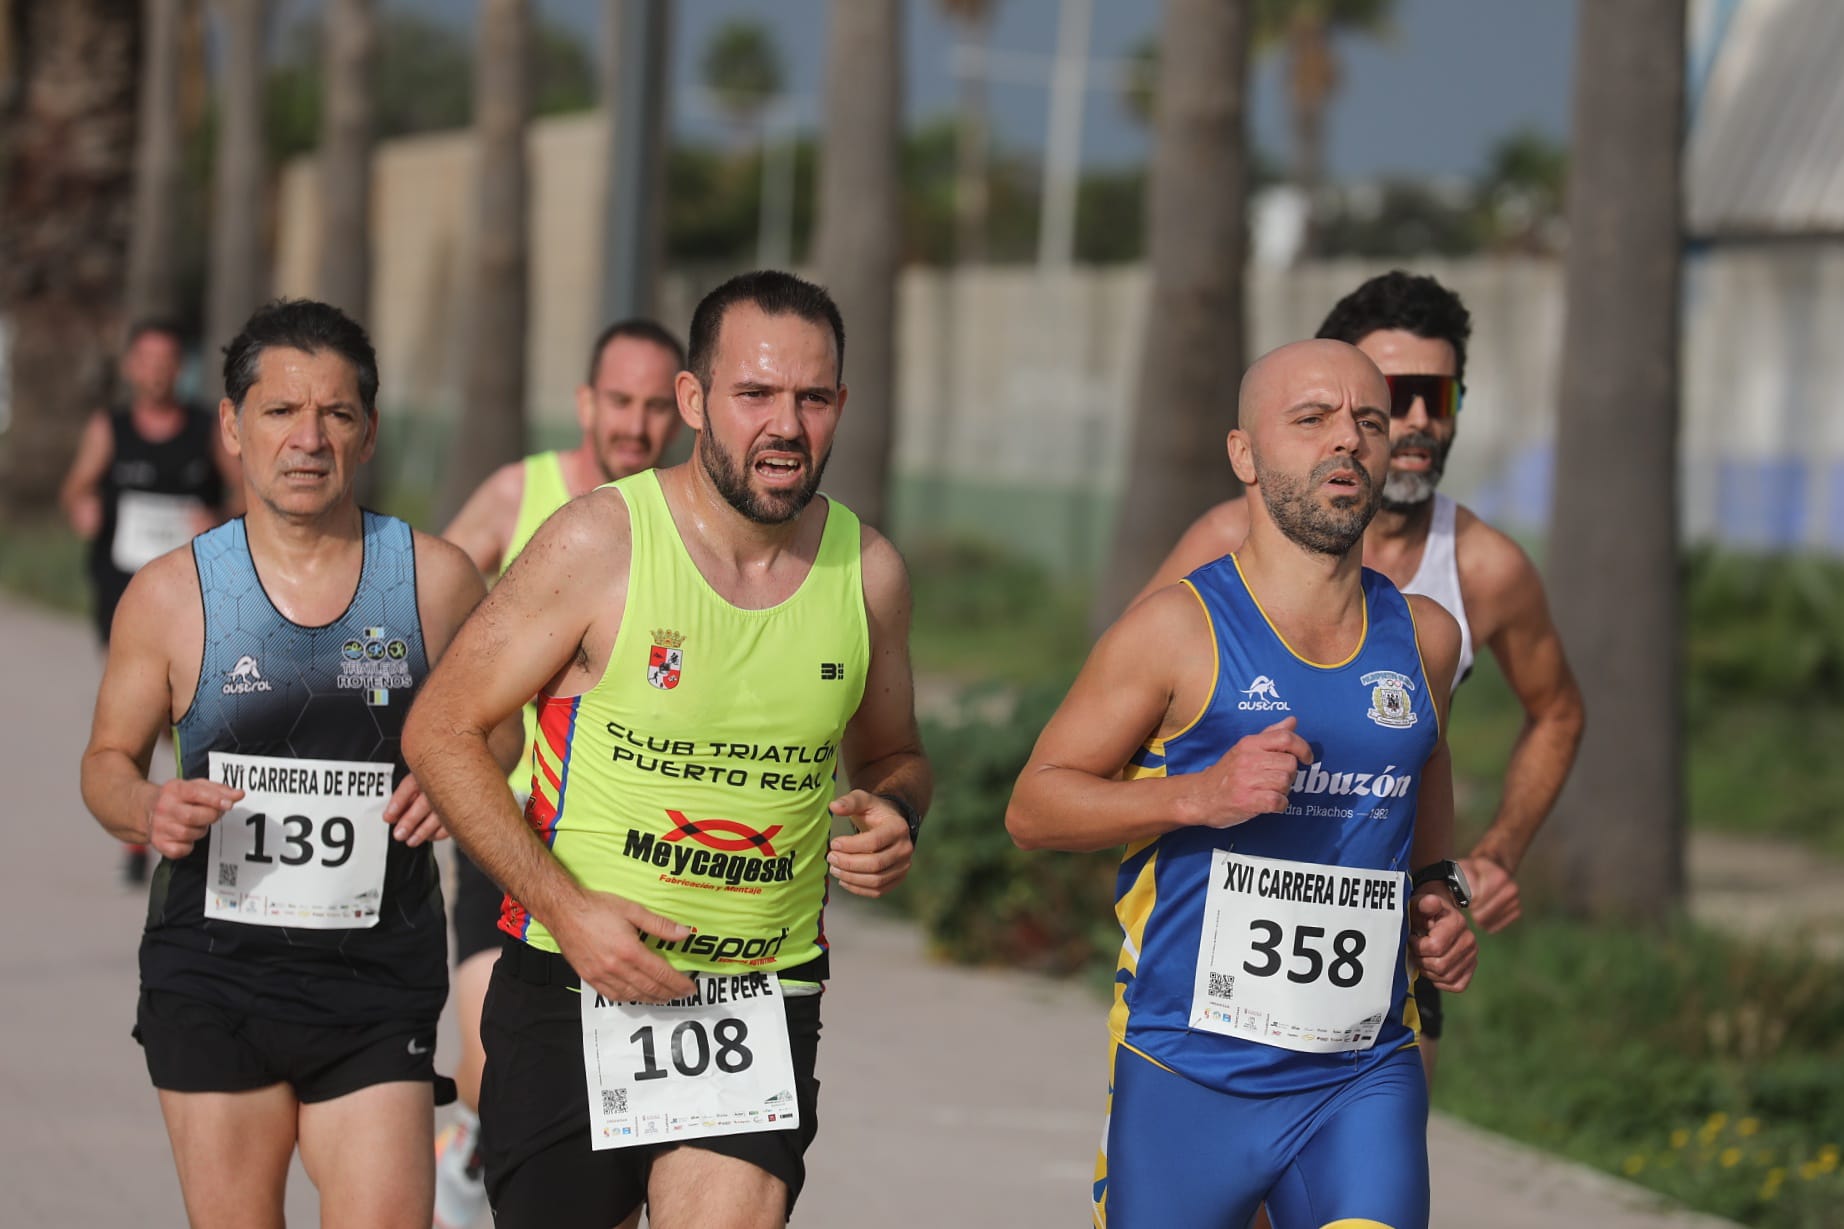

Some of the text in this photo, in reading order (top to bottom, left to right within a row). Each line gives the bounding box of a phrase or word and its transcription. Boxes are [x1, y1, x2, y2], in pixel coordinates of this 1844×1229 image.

[606, 722, 695, 756] CLUB
[222, 763, 385, 797] XVI CARRERA DE PEPE
[612, 746, 822, 791] PUERTO REAL
[1305, 805, 1354, 818] Pikachos
[245, 813, 355, 867] 139
[659, 874, 714, 889] Fabricación
[724, 886, 762, 895] Montaje
[1224, 861, 1397, 910] XVI CARRERA DE PEPE
[1242, 919, 1367, 988] 358
[707, 975, 728, 1005] DE
[731, 972, 773, 1001] PEPE
[629, 1018, 754, 1081] 108
